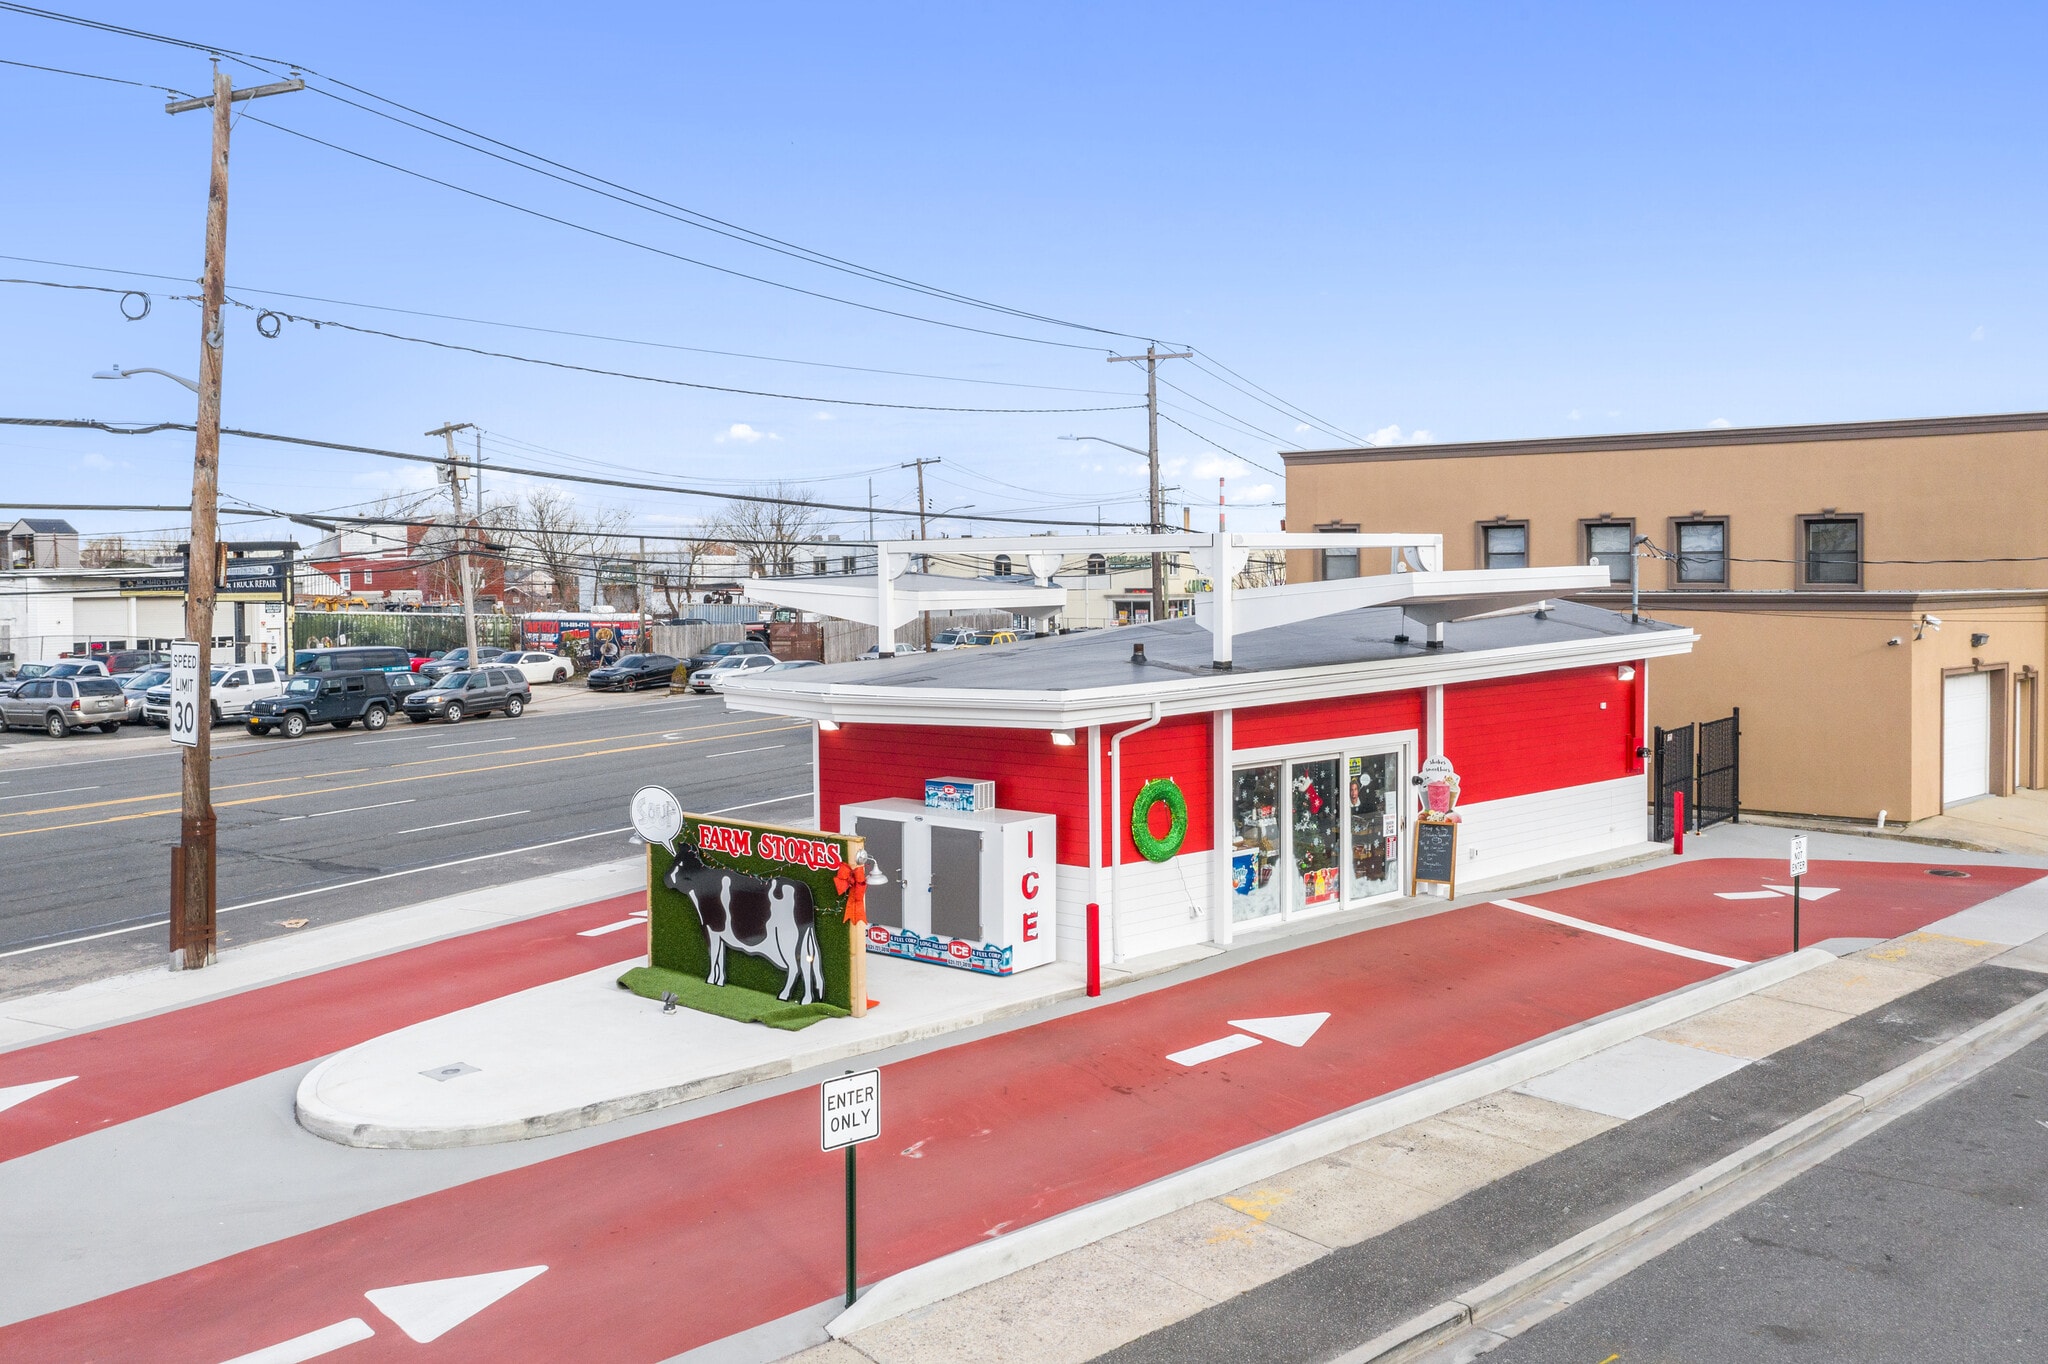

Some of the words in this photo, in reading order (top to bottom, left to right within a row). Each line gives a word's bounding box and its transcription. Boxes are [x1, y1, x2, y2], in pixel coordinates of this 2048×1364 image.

[255, 579, 277, 588] REPAIR
[173, 653, 197, 669] SPEED
[175, 678, 194, 692] LIMIT
[174, 701, 194, 733] 30
[698, 824, 752, 857] FARM
[758, 833, 842, 871] STORES
[1796, 841, 1802, 849] DO
[1794, 850, 1803, 860] NOT
[1792, 860, 1805, 872] ENTER
[1021, 826, 1040, 942] ICE
[870, 930, 888, 942] ICE
[951, 945, 969, 957] ICE
[828, 1086, 874, 1111] ENTER
[831, 1108, 871, 1132] ONLY
